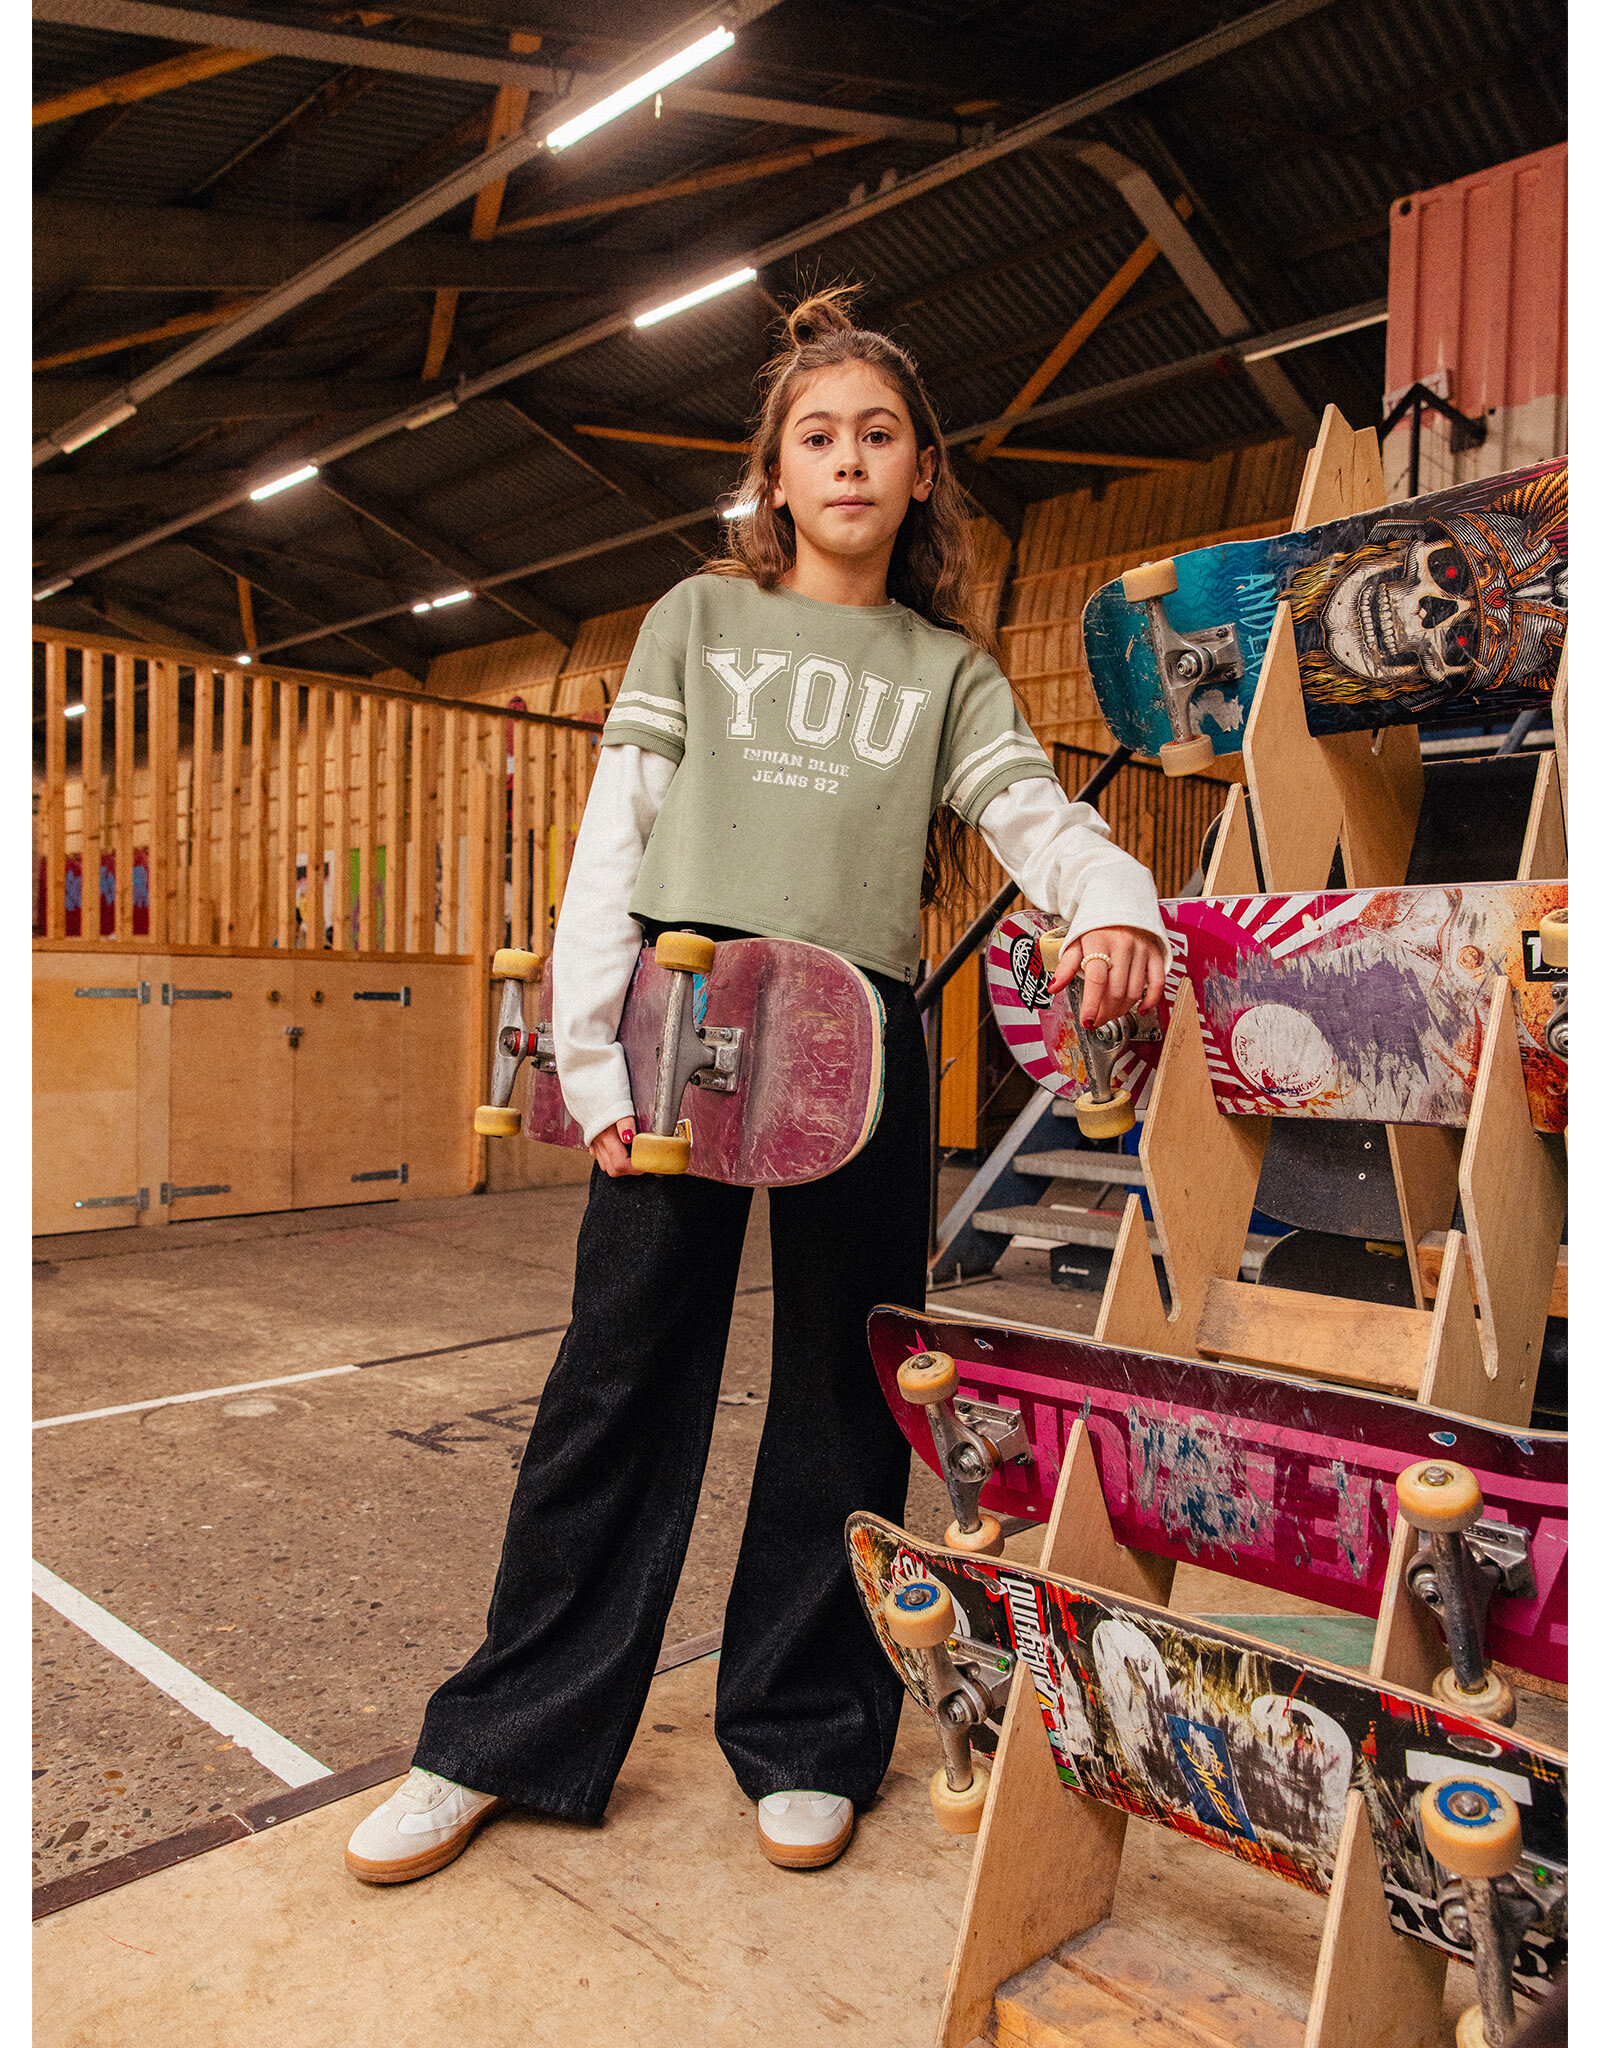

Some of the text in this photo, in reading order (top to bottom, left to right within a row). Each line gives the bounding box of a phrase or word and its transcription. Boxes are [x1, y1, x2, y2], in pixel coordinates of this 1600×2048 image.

[702, 645, 931, 771] YOU
[743, 747, 851, 778] INDIAN BLUE
[751, 769, 839, 796] JEANS 82
